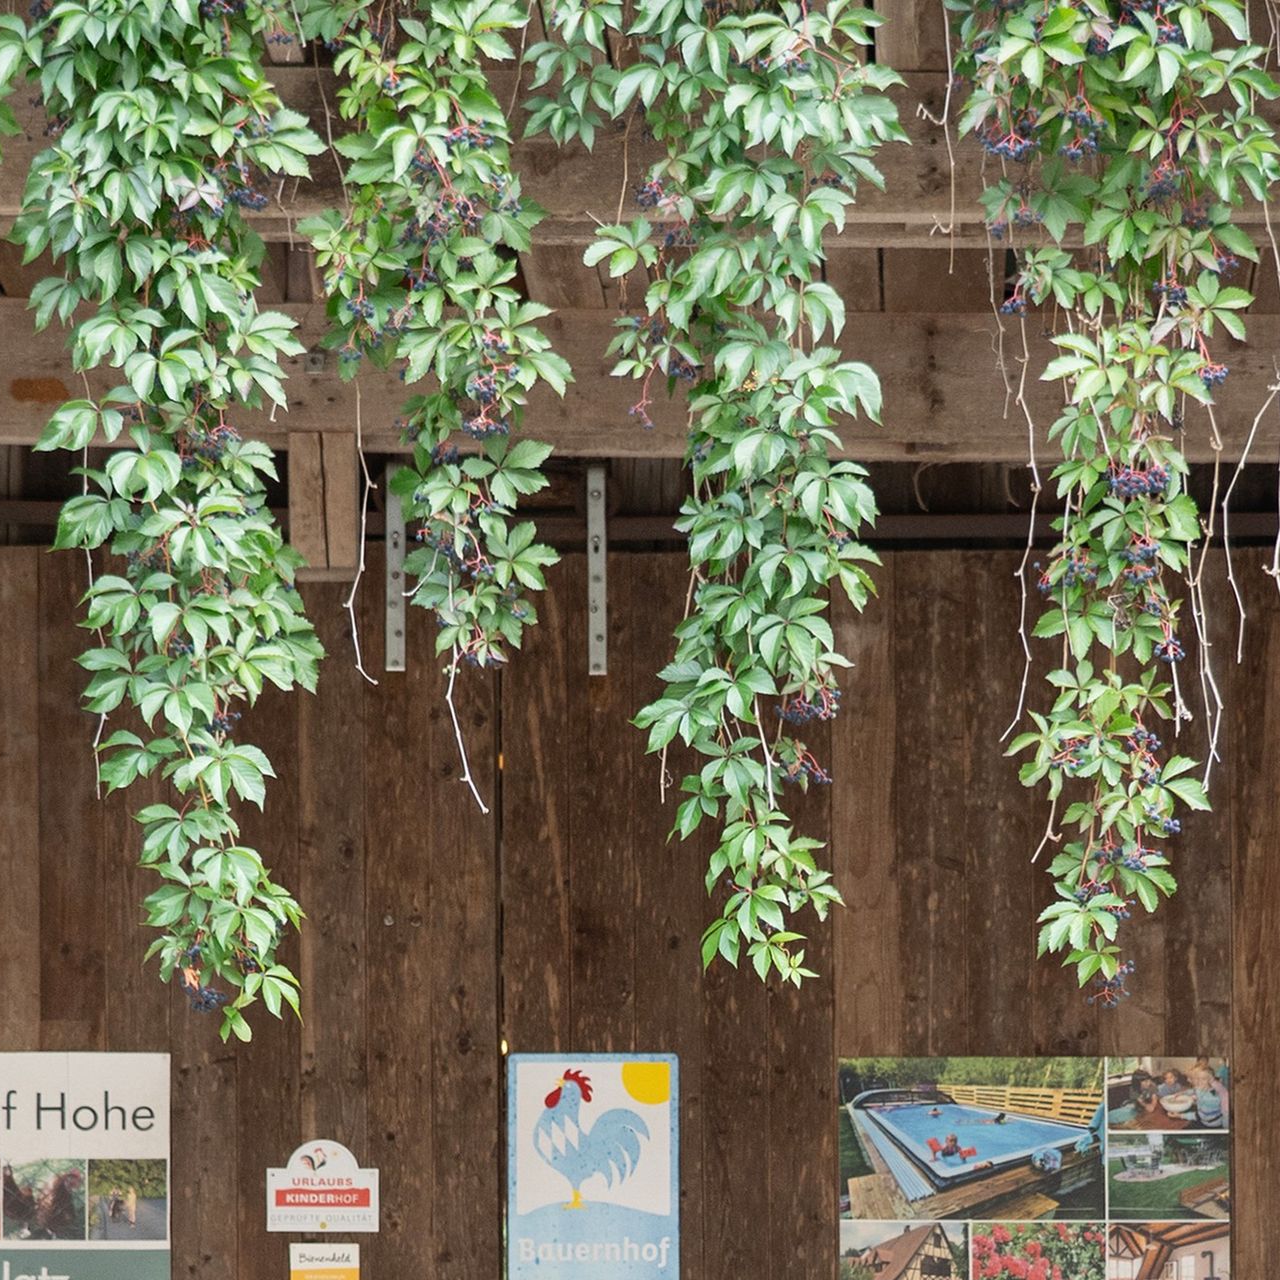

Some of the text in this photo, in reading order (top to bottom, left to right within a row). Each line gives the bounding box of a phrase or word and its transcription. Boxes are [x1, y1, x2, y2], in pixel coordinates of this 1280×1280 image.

[36, 1091, 155, 1131] Hohe
[292, 1178, 353, 1187] URLAUBS
[285, 1193, 360, 1204] KINDERHOF
[518, 1236, 670, 1269] Bauernhof
